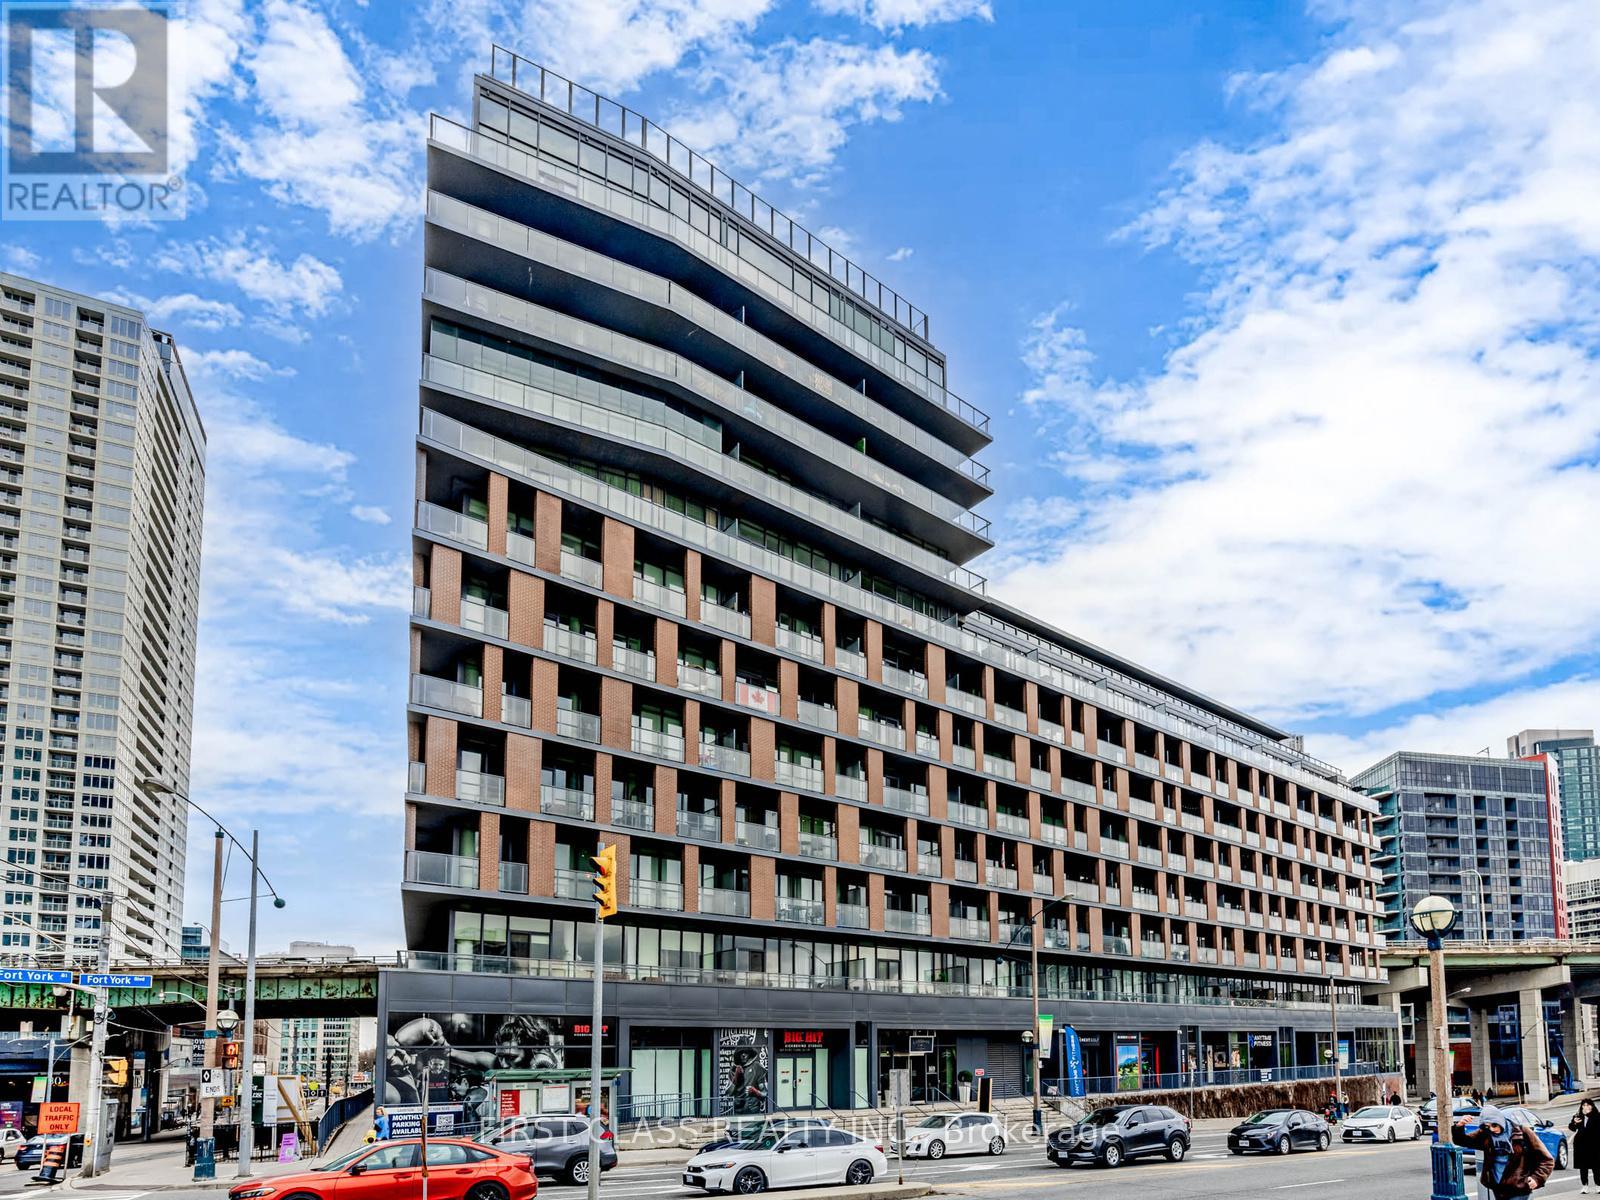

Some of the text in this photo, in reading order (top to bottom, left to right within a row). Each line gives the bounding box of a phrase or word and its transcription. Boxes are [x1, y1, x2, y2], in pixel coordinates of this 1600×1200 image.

[0, 970, 23, 980] Fort
[27, 971, 54, 981] York
[87, 975, 108, 984] Fort
[110, 976, 131, 985] York
[574, 1024, 590, 1033] BIG
[784, 1031, 824, 1043] BIG HIT
[44, 1114, 75, 1122] TRAFFIC
[49, 1123, 70, 1131] ONLY
